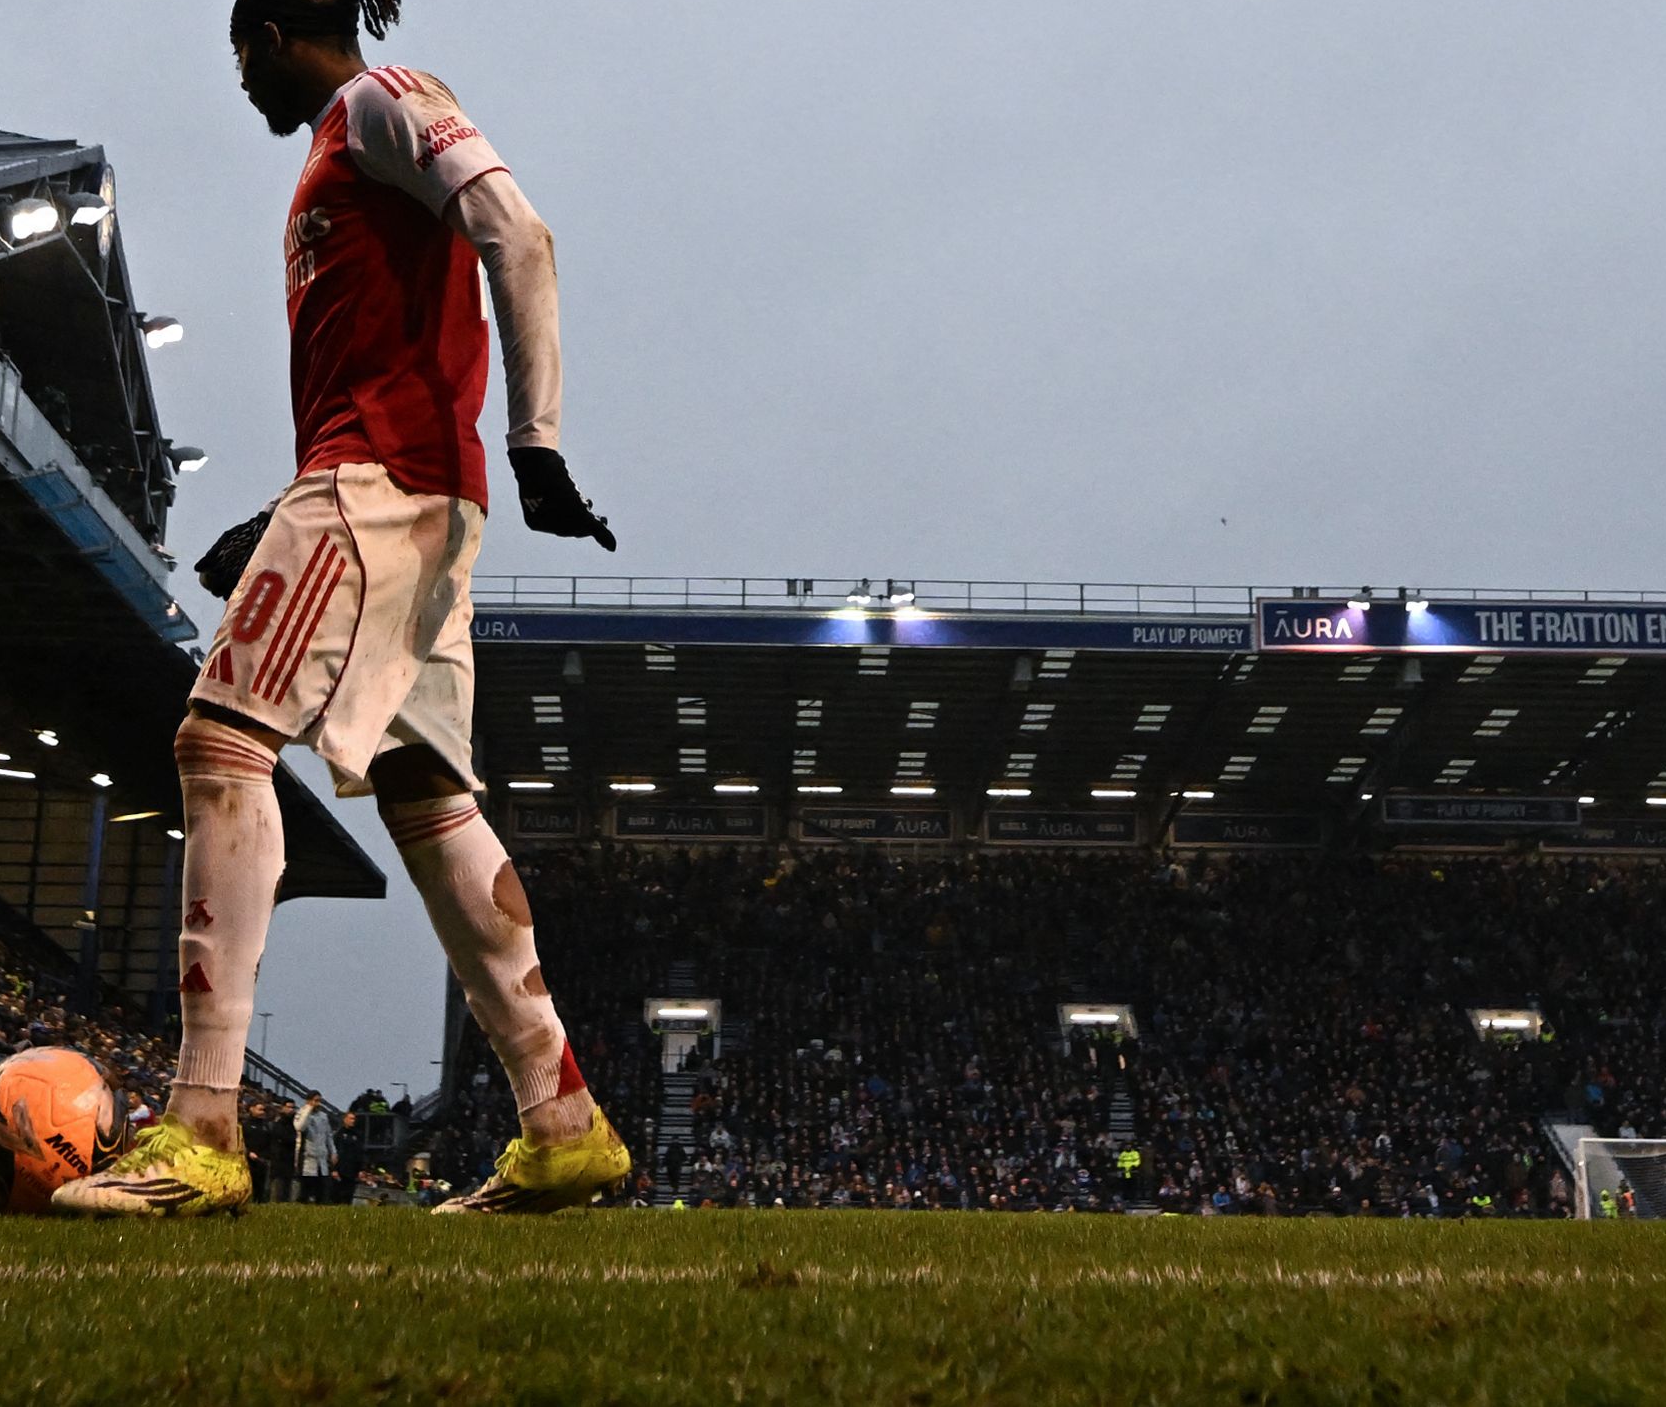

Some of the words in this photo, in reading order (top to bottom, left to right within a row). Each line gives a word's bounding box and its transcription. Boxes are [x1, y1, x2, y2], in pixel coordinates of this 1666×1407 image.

[417, 116, 458, 143] VISIT
[416, 127, 483, 171] RWANDA
[474, 620, 520, 637] URA
[1133, 627, 1165, 643] PLAY
[1169, 627, 1186, 644] UP
[1190, 628, 1244, 644] POMPEY
[1475, 611, 1524, 642] THE
[1529, 612, 1639, 643] FRATTON
[44, 1133, 89, 1175] Mitre
